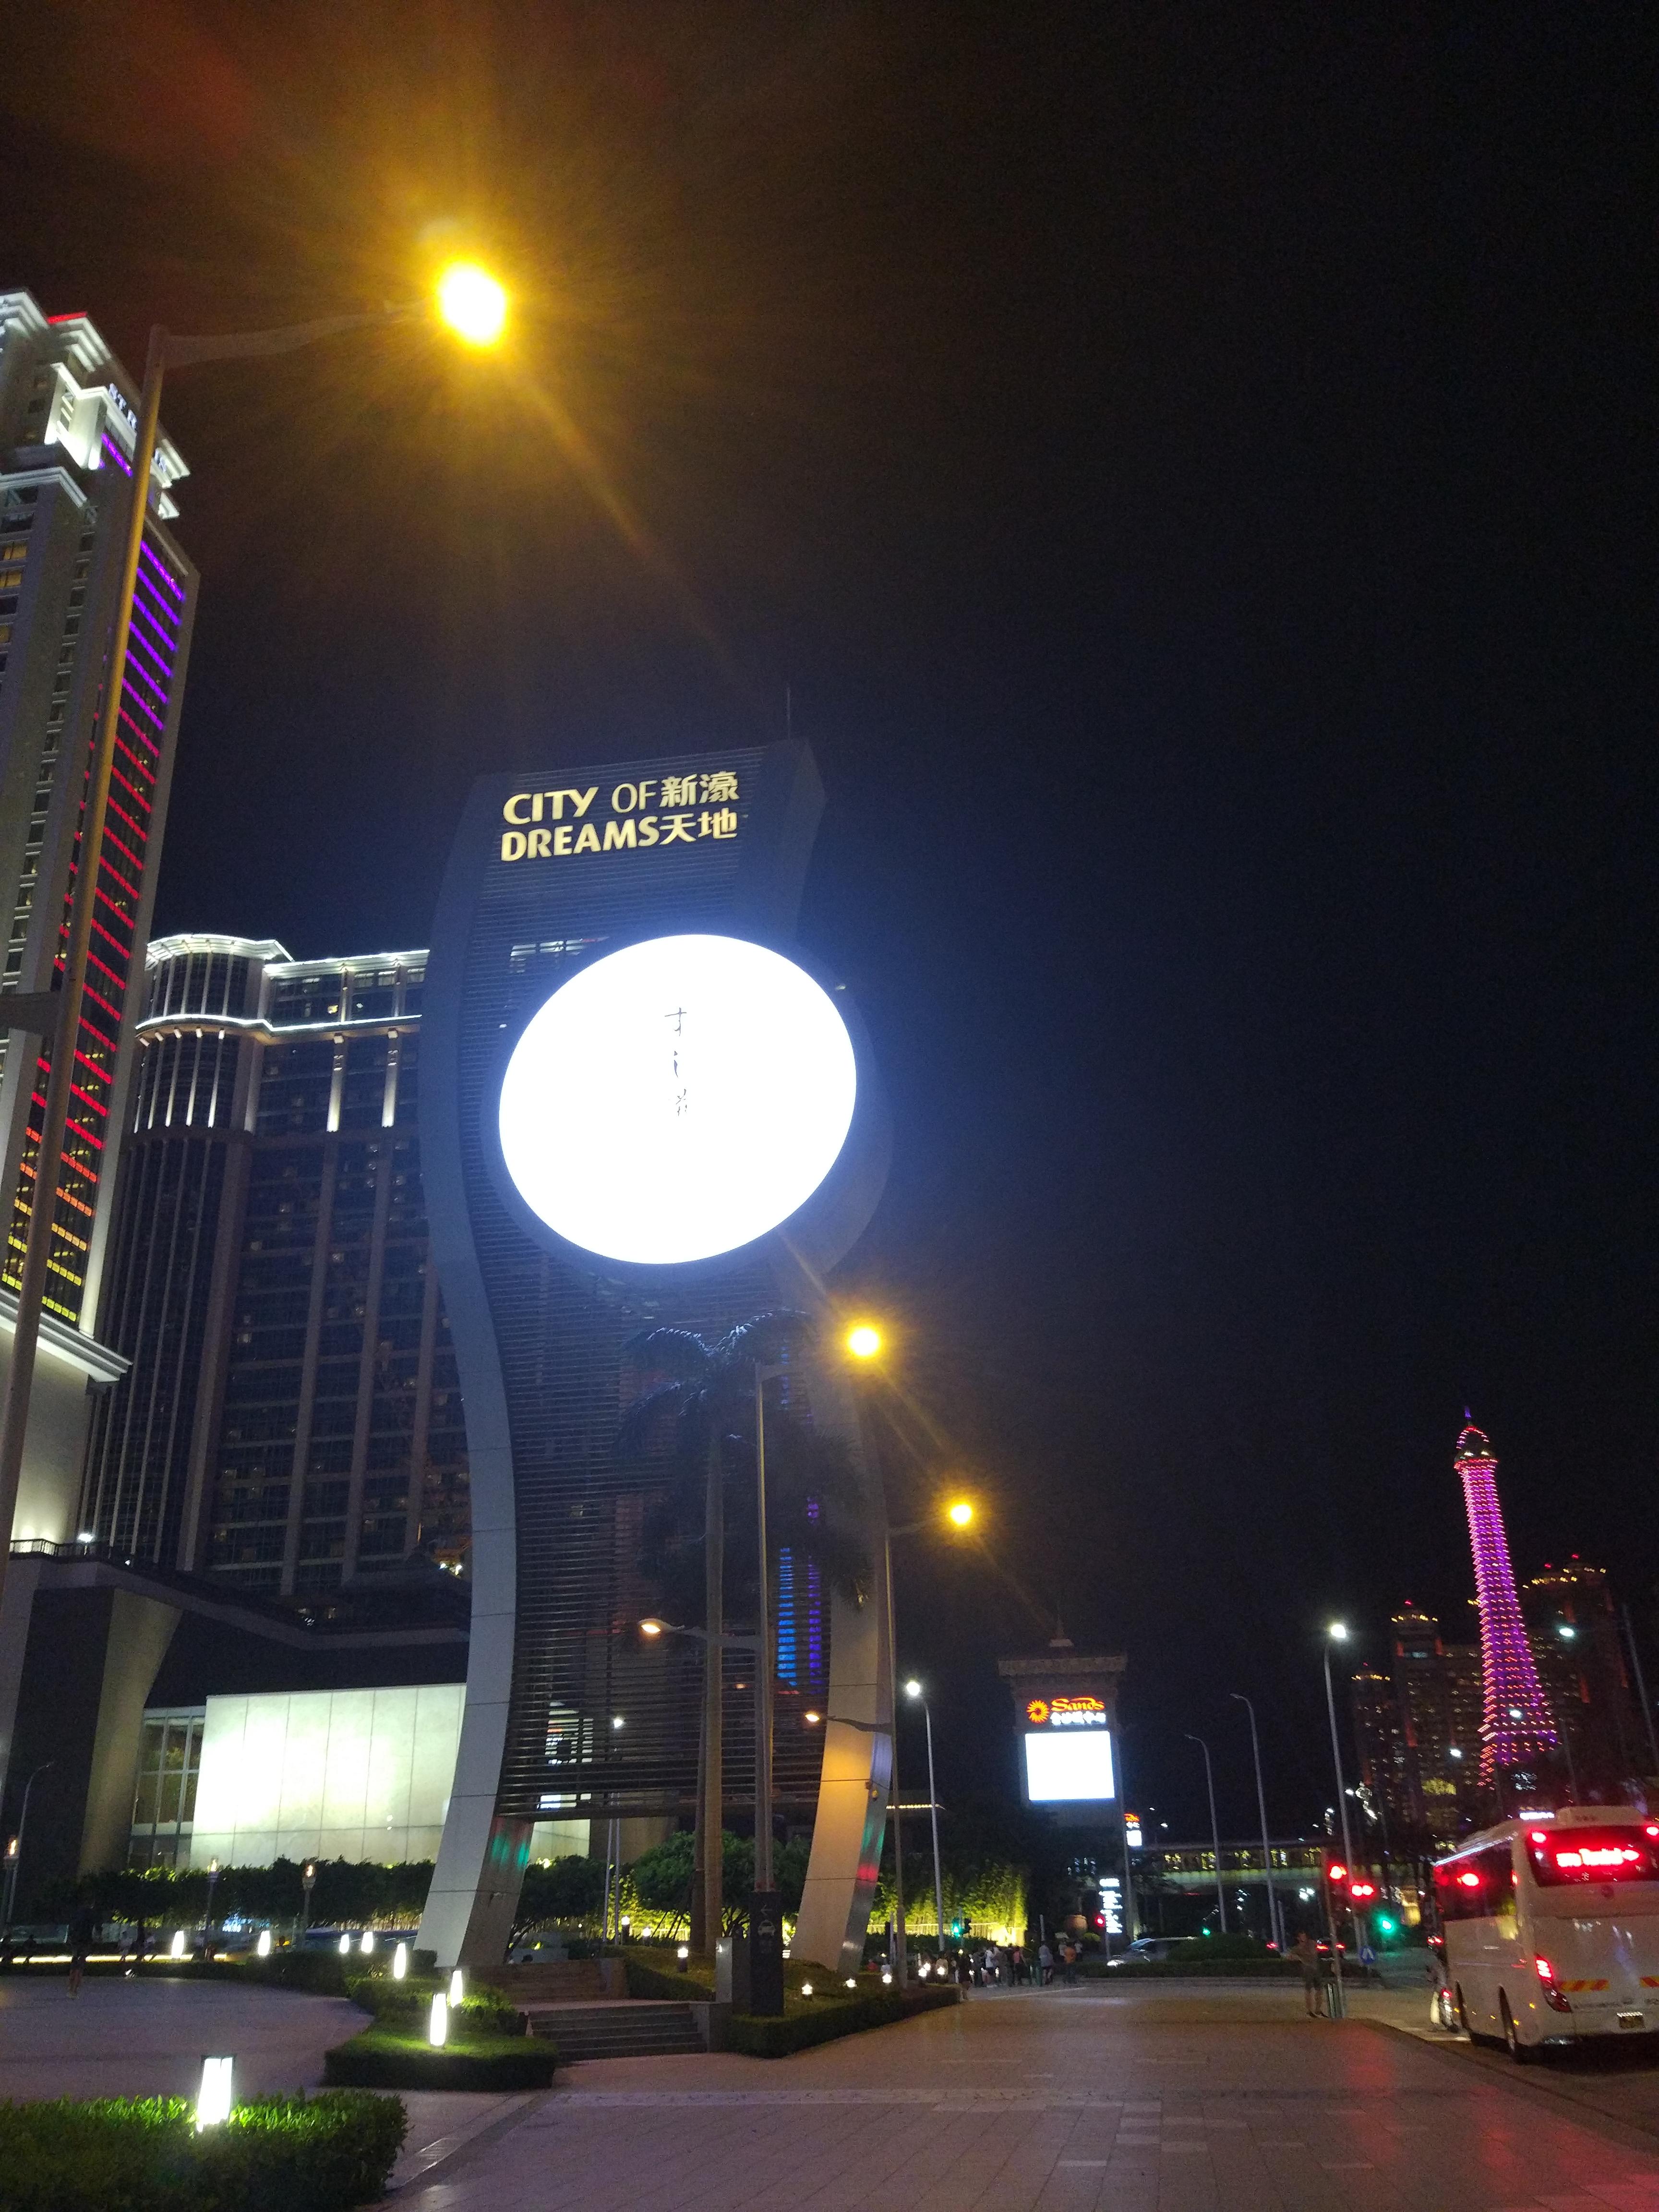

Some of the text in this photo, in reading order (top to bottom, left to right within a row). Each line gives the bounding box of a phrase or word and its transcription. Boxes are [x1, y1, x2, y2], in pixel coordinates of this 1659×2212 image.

[503, 780, 658, 825] CITY OF
[660, 771, 740, 808] 新濠
[501, 815, 660, 862] DREAMS
[660, 807, 738, 845] 天地
[1050, 1696, 1105, 1711] Sands
